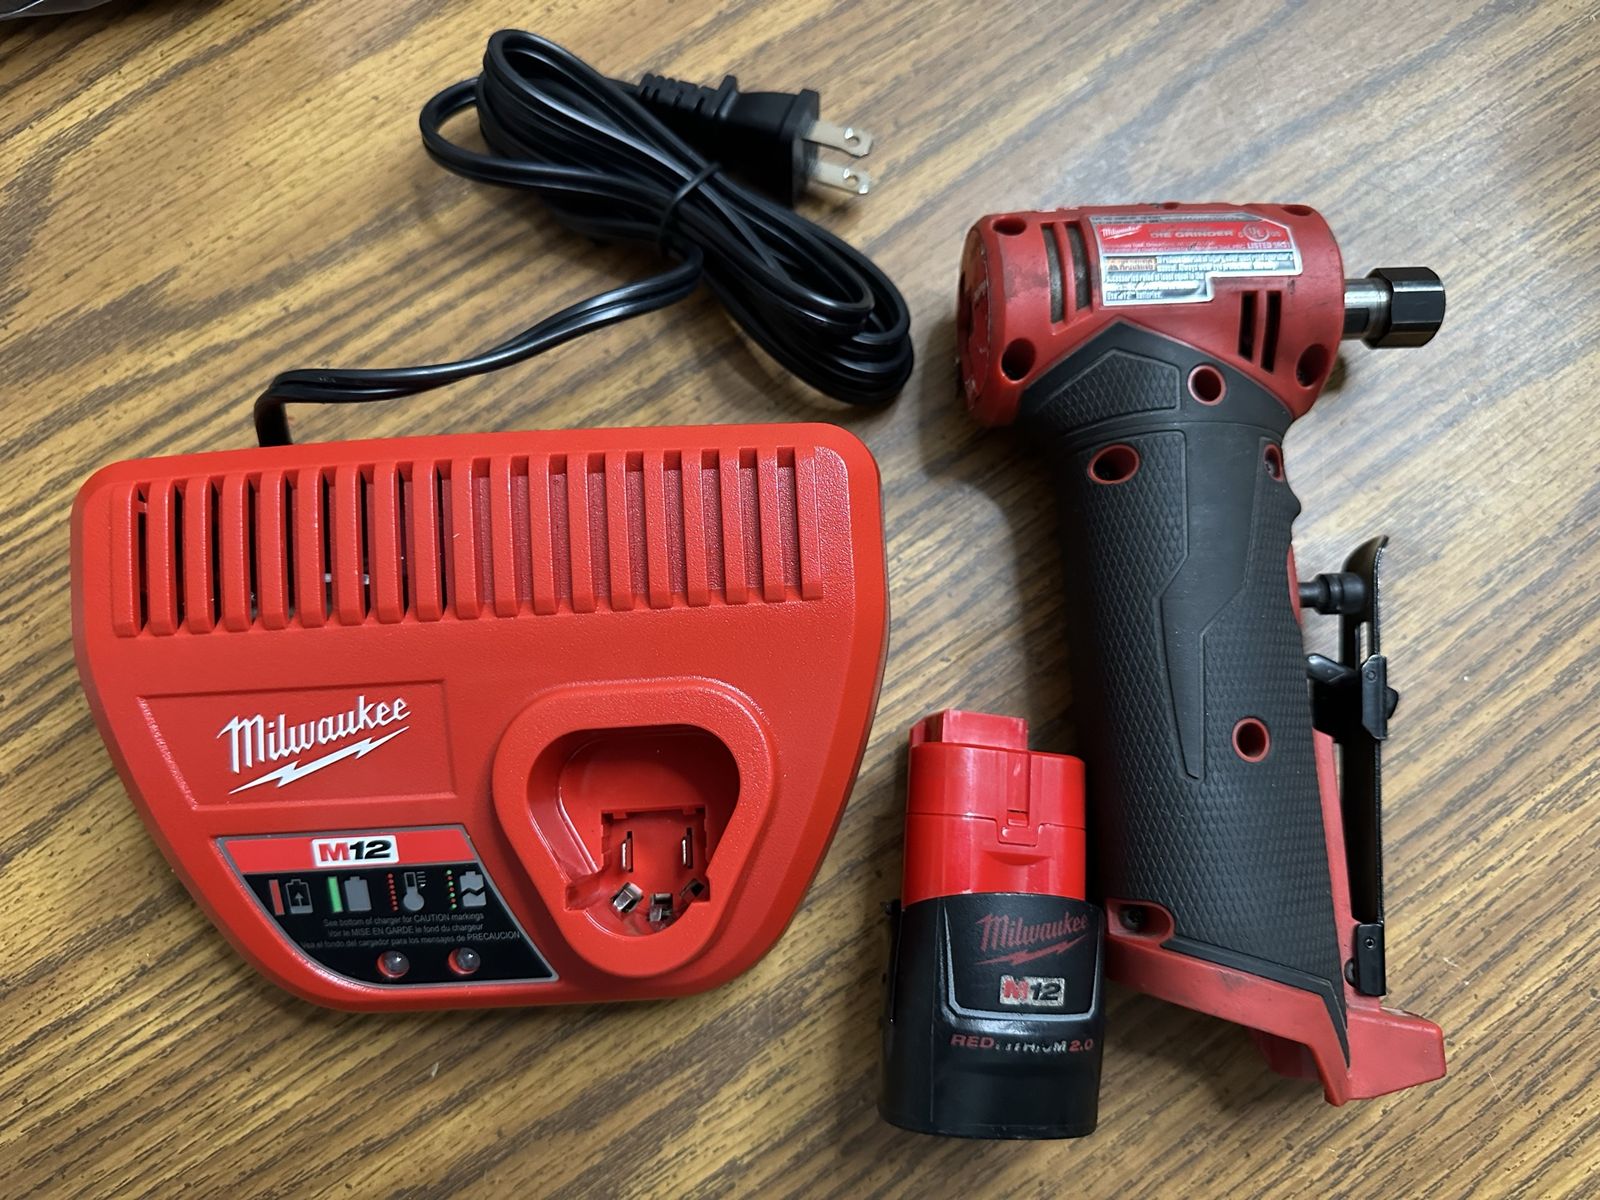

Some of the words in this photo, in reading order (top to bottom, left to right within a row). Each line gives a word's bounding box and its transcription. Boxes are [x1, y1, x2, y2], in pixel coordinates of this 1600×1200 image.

[1175, 229, 1234, 238] GRINDER
[216, 695, 411, 774] Milwaukee
[318, 840, 392, 862] M12
[340, 918, 364, 927] bottom
[375, 916, 401, 927] charger
[402, 915, 412, 923] for
[413, 913, 450, 922] CAUTION
[451, 912, 484, 922] markings
[351, 927, 371, 937] MISE
[373, 927, 384, 935] EN
[385, 925, 414, 935] GARDE
[423, 924, 440, 933] fond
[451, 923, 484, 933] chargeur
[466, 931, 520, 941] PRECAUCION
[975, 911, 1089, 952] Milwaukee
[1002, 979, 1062, 1001] M12
[1068, 1038, 1095, 1052] 2.0
